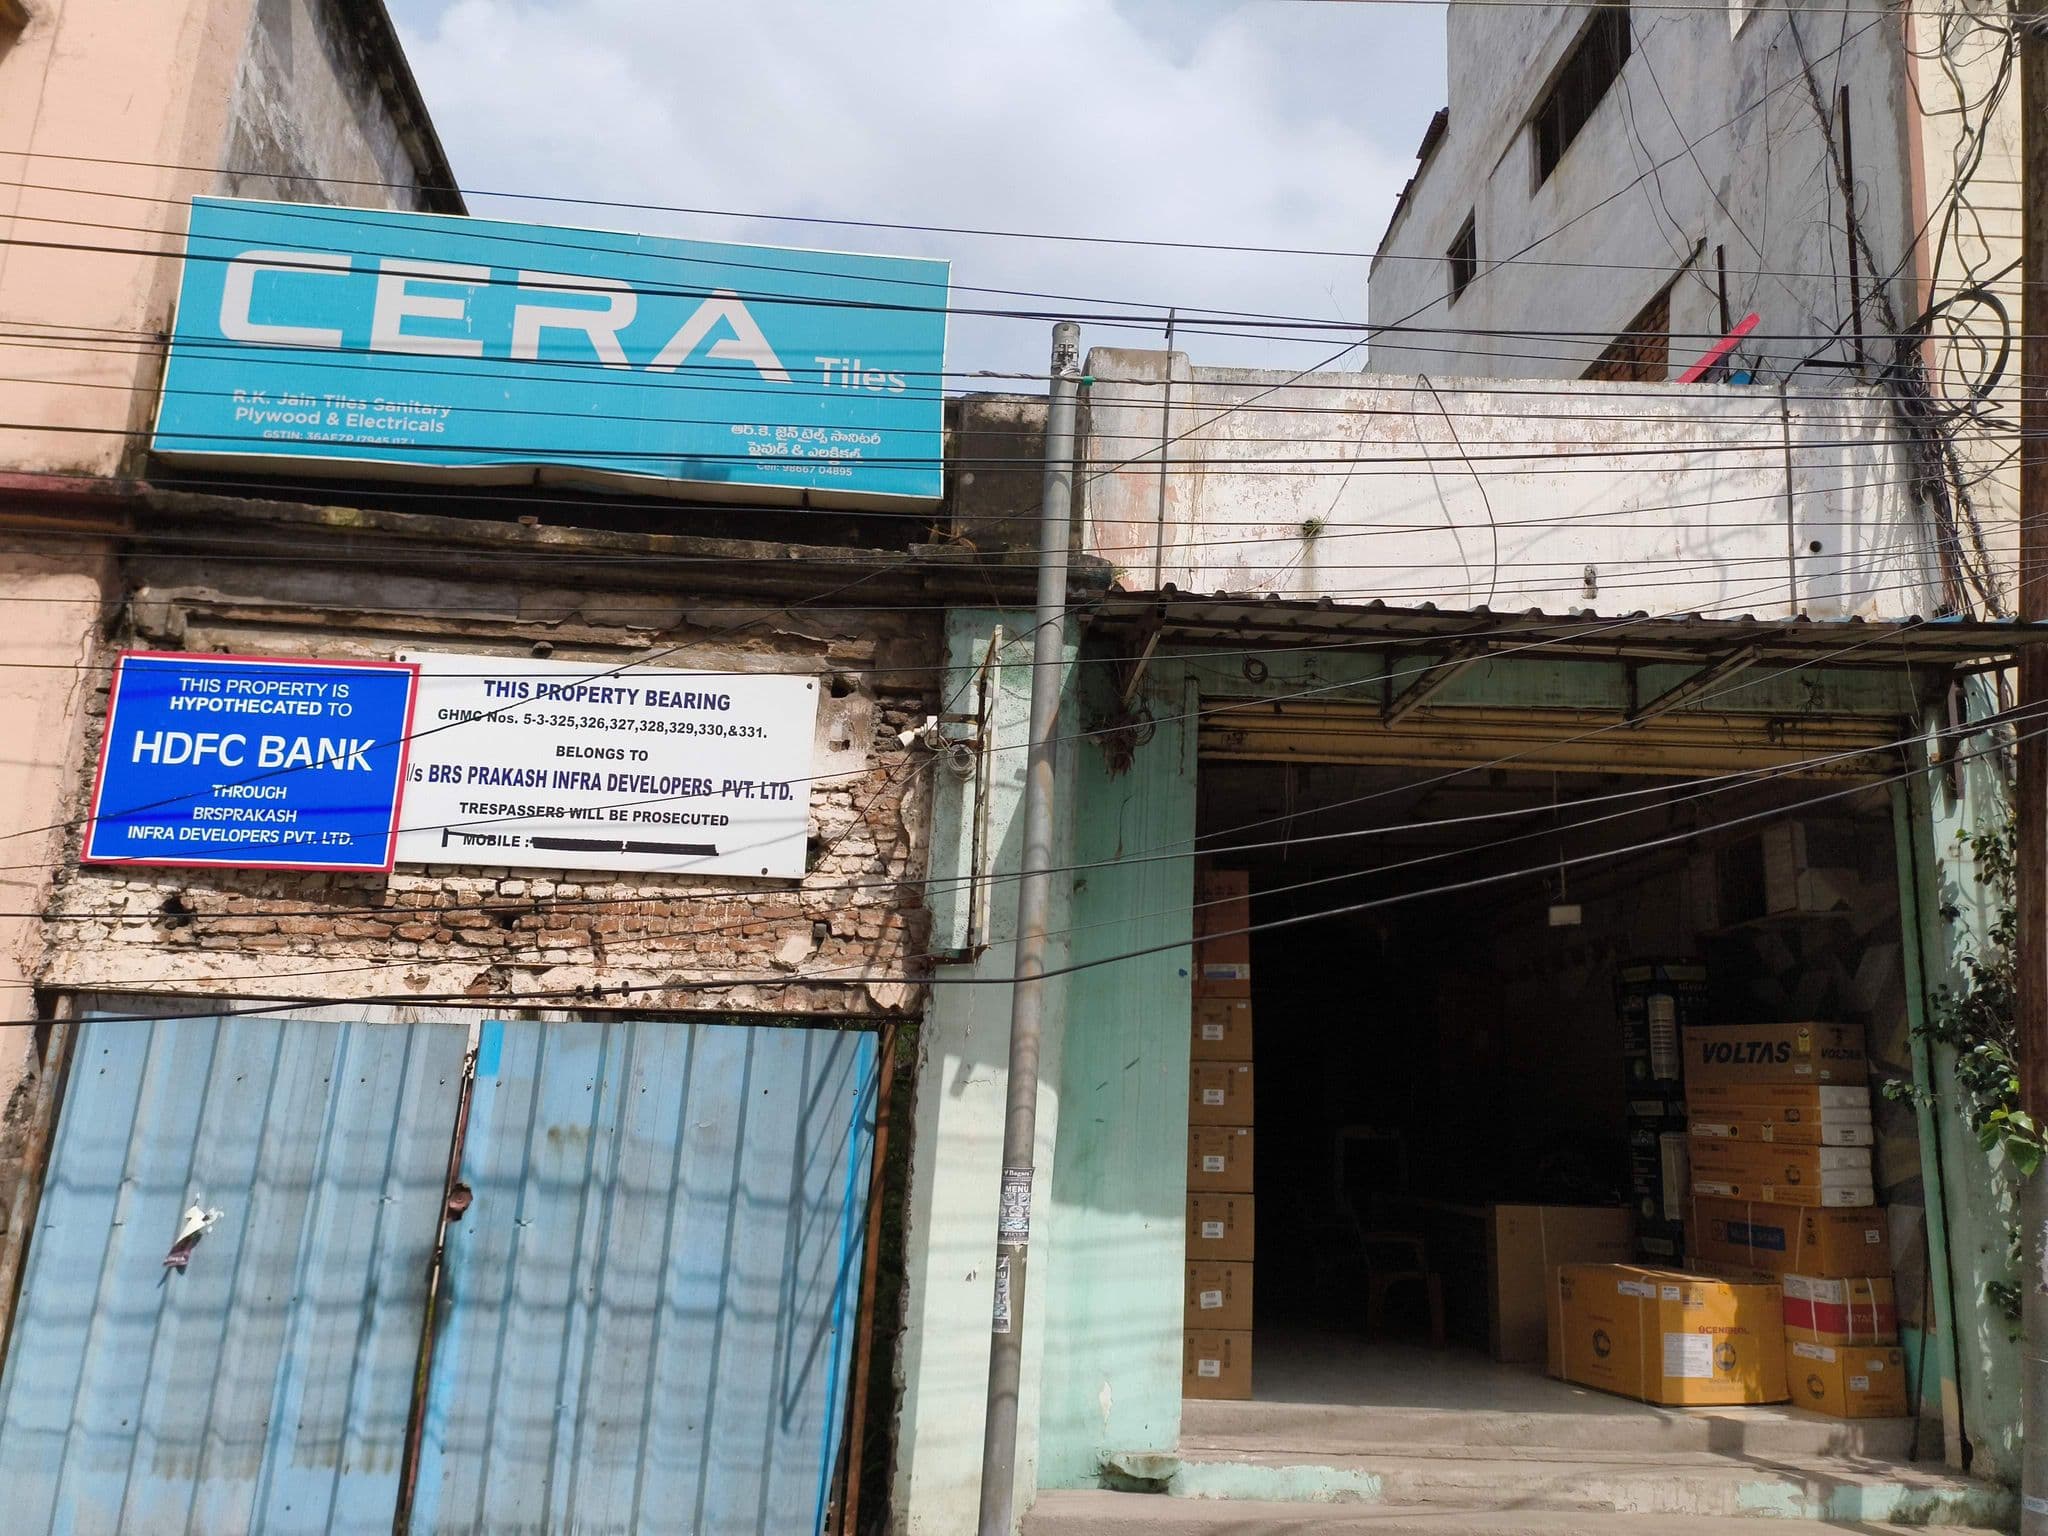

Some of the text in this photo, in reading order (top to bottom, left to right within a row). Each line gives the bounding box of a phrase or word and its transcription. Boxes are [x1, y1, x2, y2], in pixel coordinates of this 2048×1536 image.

[219, 249, 794, 384] CERA
[814, 355, 907, 393] Tiles
[232, 388, 453, 418] R.K. Jain Tiles Sanitary
[234, 406, 446, 434] Plywood & Electricals
[262, 429, 304, 441] GSTIN:
[791, 443, 804, 457] &
[818, 465, 853, 477] 04895
[179, 677, 350, 698] THIS PROPERTY IS
[484, 679, 731, 712] THIS PROPERTY BEARING
[170, 696, 353, 717] HYPOTHECATED TO
[437, 707, 769, 740] GHMC Nos. 5-3-325,326,327,328,329,330,&331.
[131, 729, 377, 772] HDFC BANK
[555, 745, 649, 762] BELONGS TO
[211, 784, 288, 801] THROUGH
[405, 762, 795, 802] /s BRS PRAKASH INFRA DEVELOPERS PVT. LTD.
[192, 806, 298, 824] BRSPRAKASH
[459, 801, 730, 828] TRESPASSERS WILL BE PROSECUTED
[127, 825, 355, 847] INFRA DEVELOPERS PVT. LTD.
[463, 834, 521, 848] MOBILE
[1702, 1040, 1792, 1064] VOLTAS
[1004, 1184, 1029, 1194] MENU
